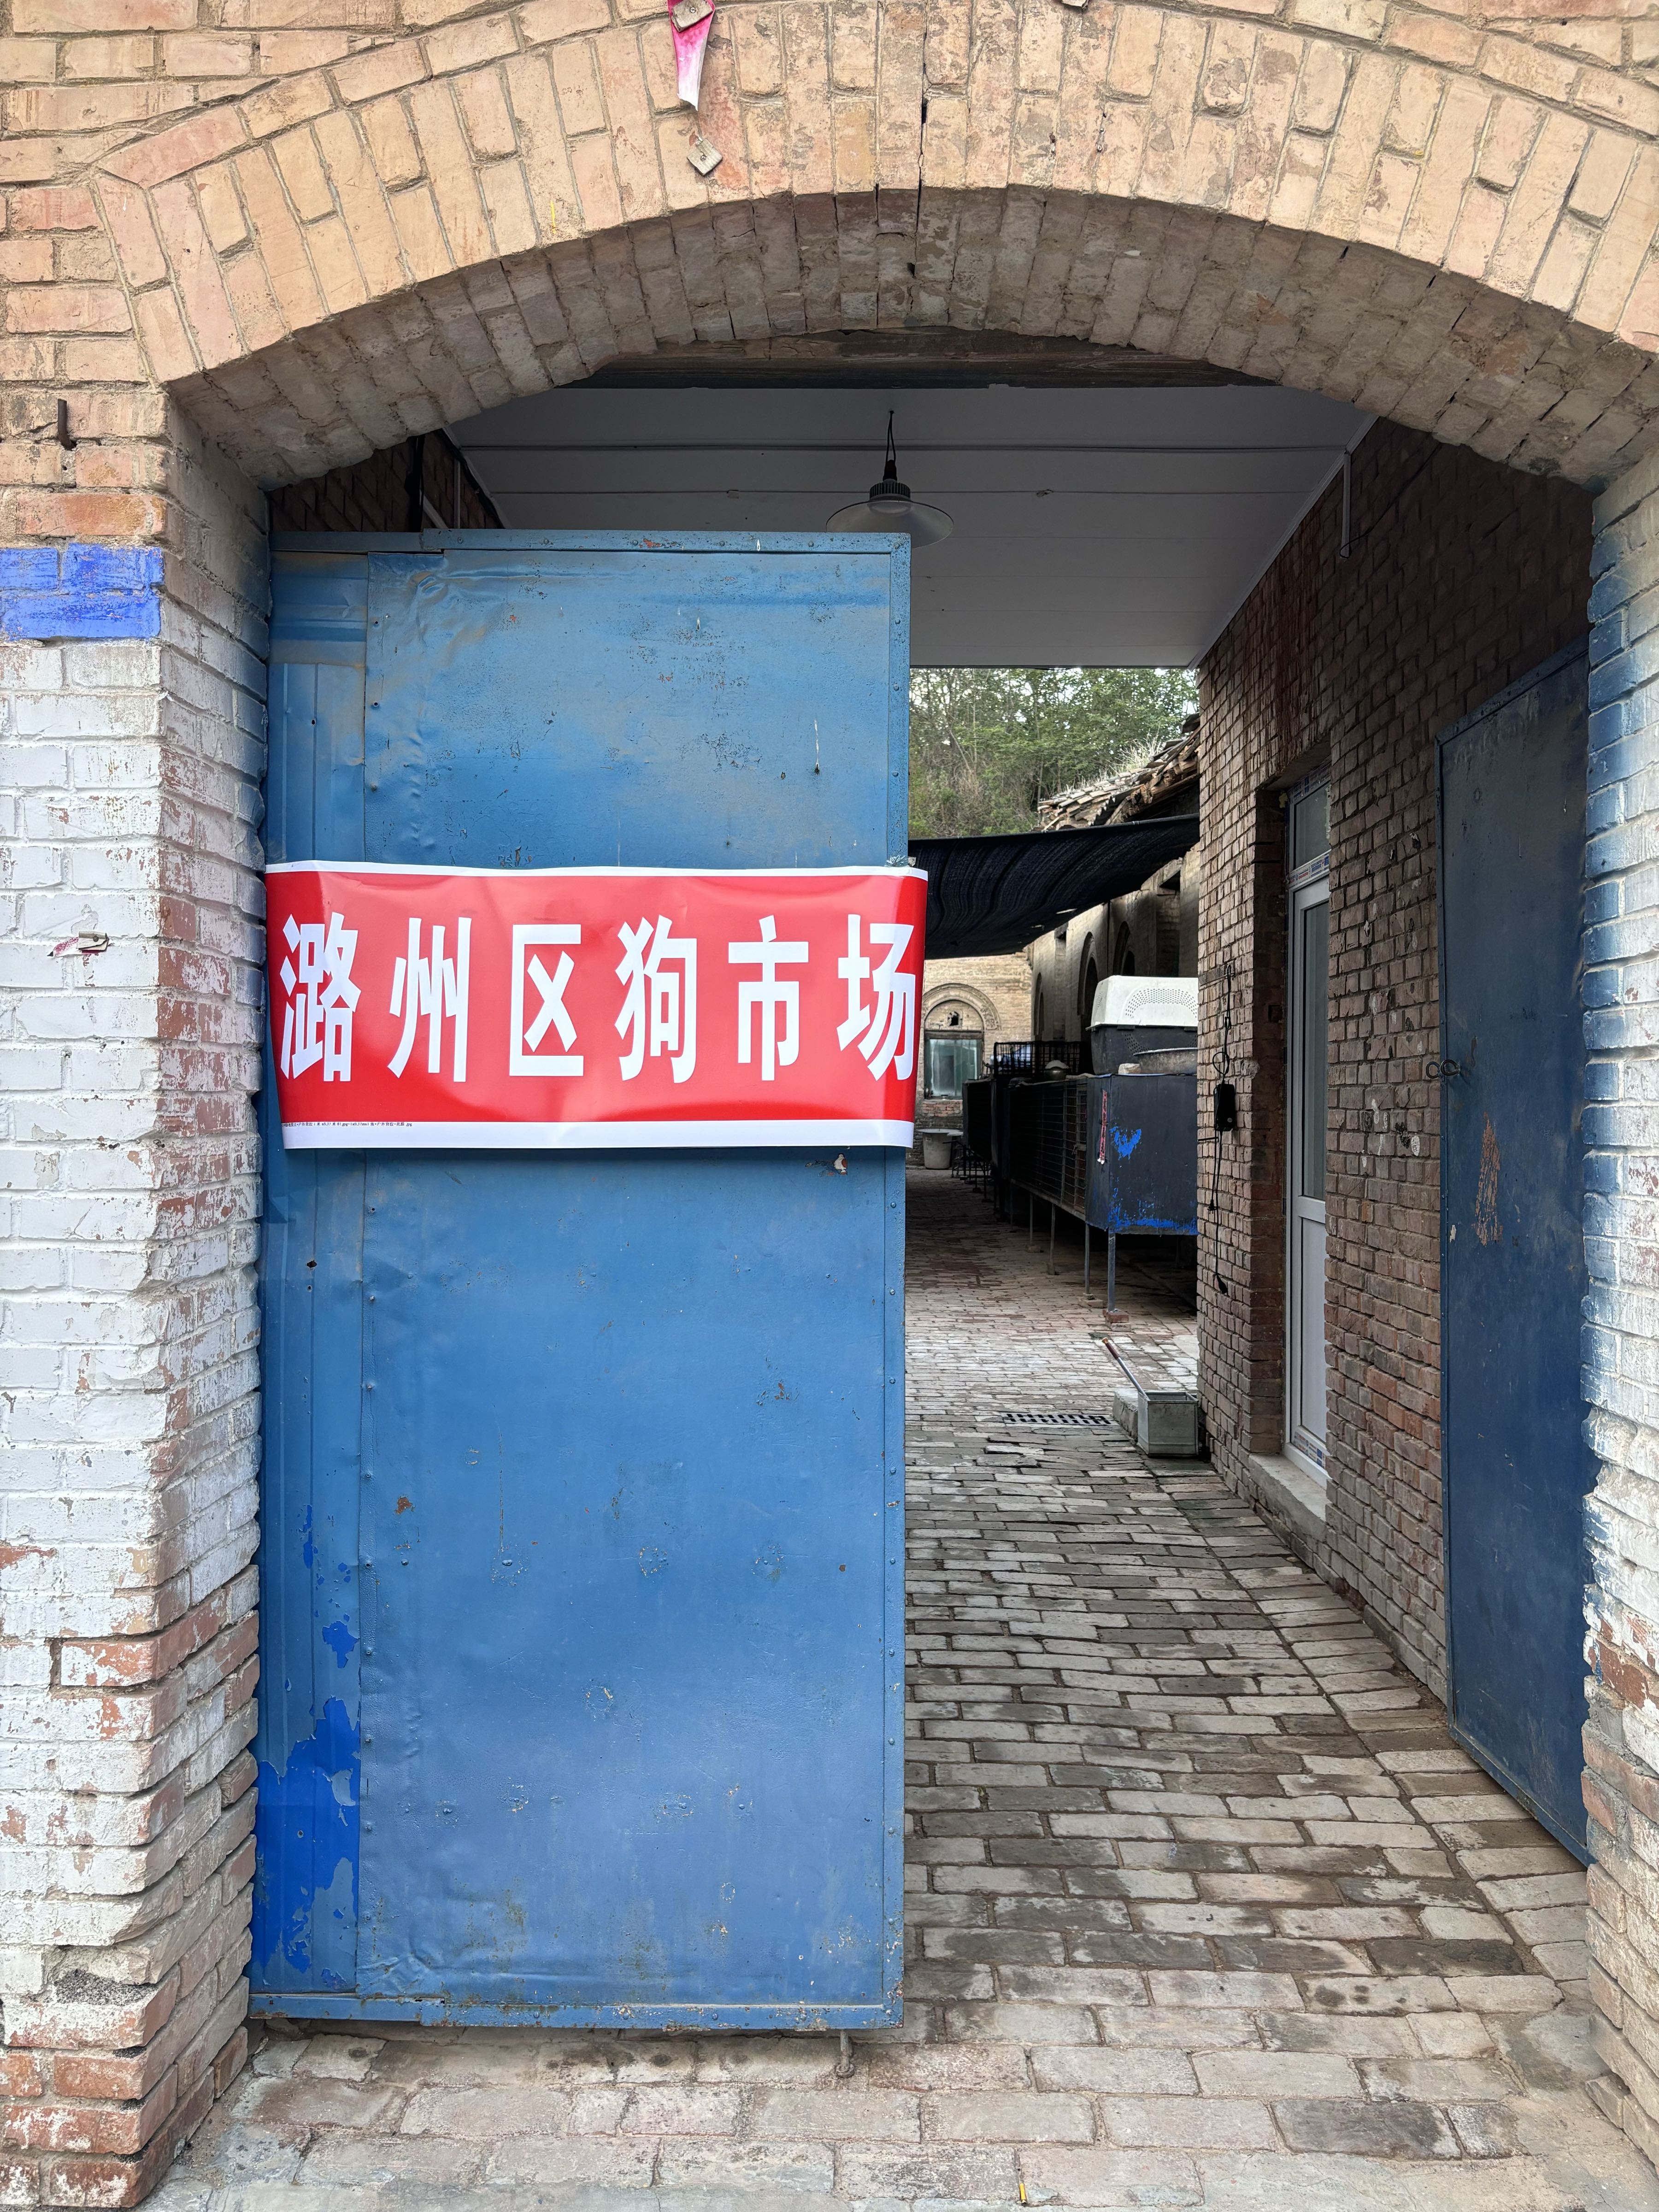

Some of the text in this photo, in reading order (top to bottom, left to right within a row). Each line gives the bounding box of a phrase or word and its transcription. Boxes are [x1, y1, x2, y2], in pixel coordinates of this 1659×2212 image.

[279, 911, 916, 1083] 潞州区狗市场
